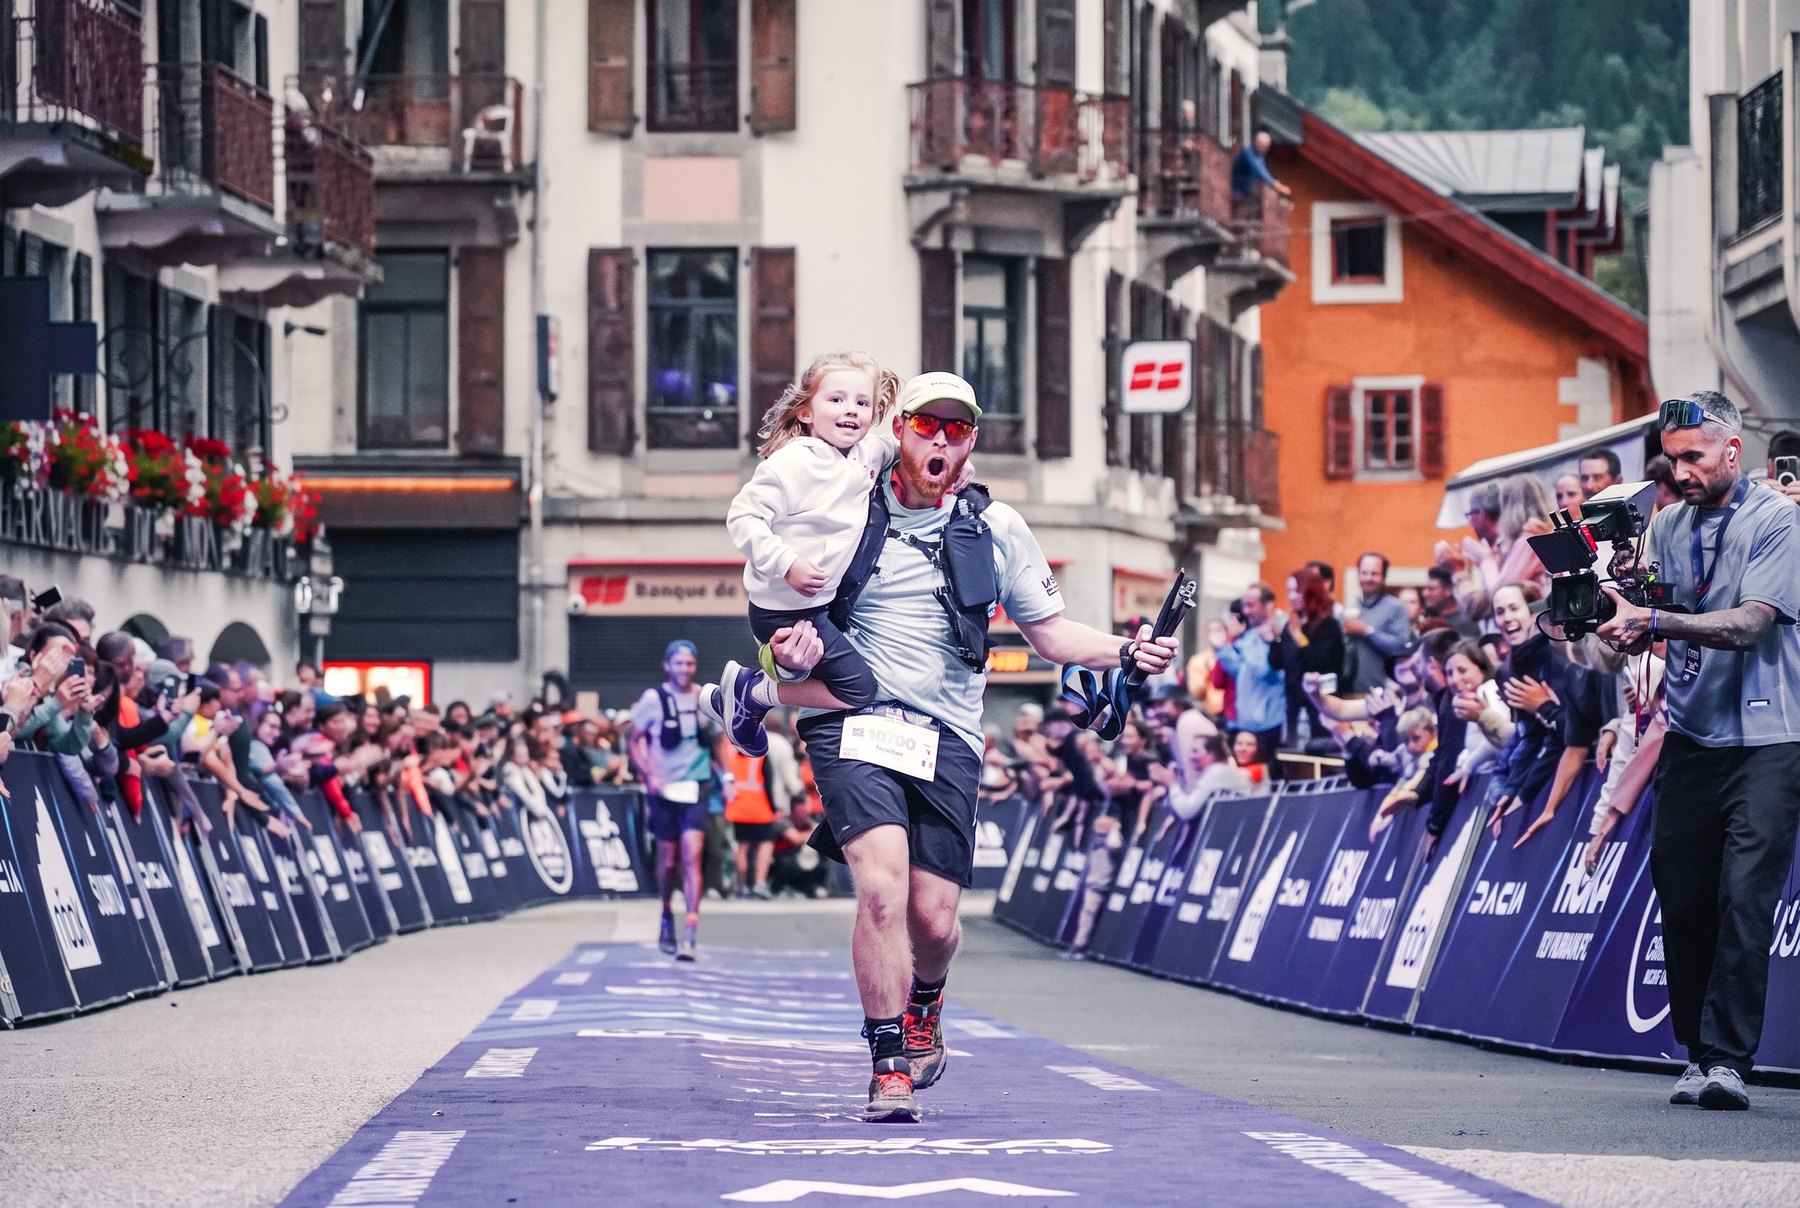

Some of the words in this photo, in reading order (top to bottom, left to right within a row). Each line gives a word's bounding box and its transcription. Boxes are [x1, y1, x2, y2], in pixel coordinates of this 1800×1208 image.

[636, 582, 707, 601] Banque
[715, 581, 737, 597] de
[1468, 880, 1528, 916] DACIA
